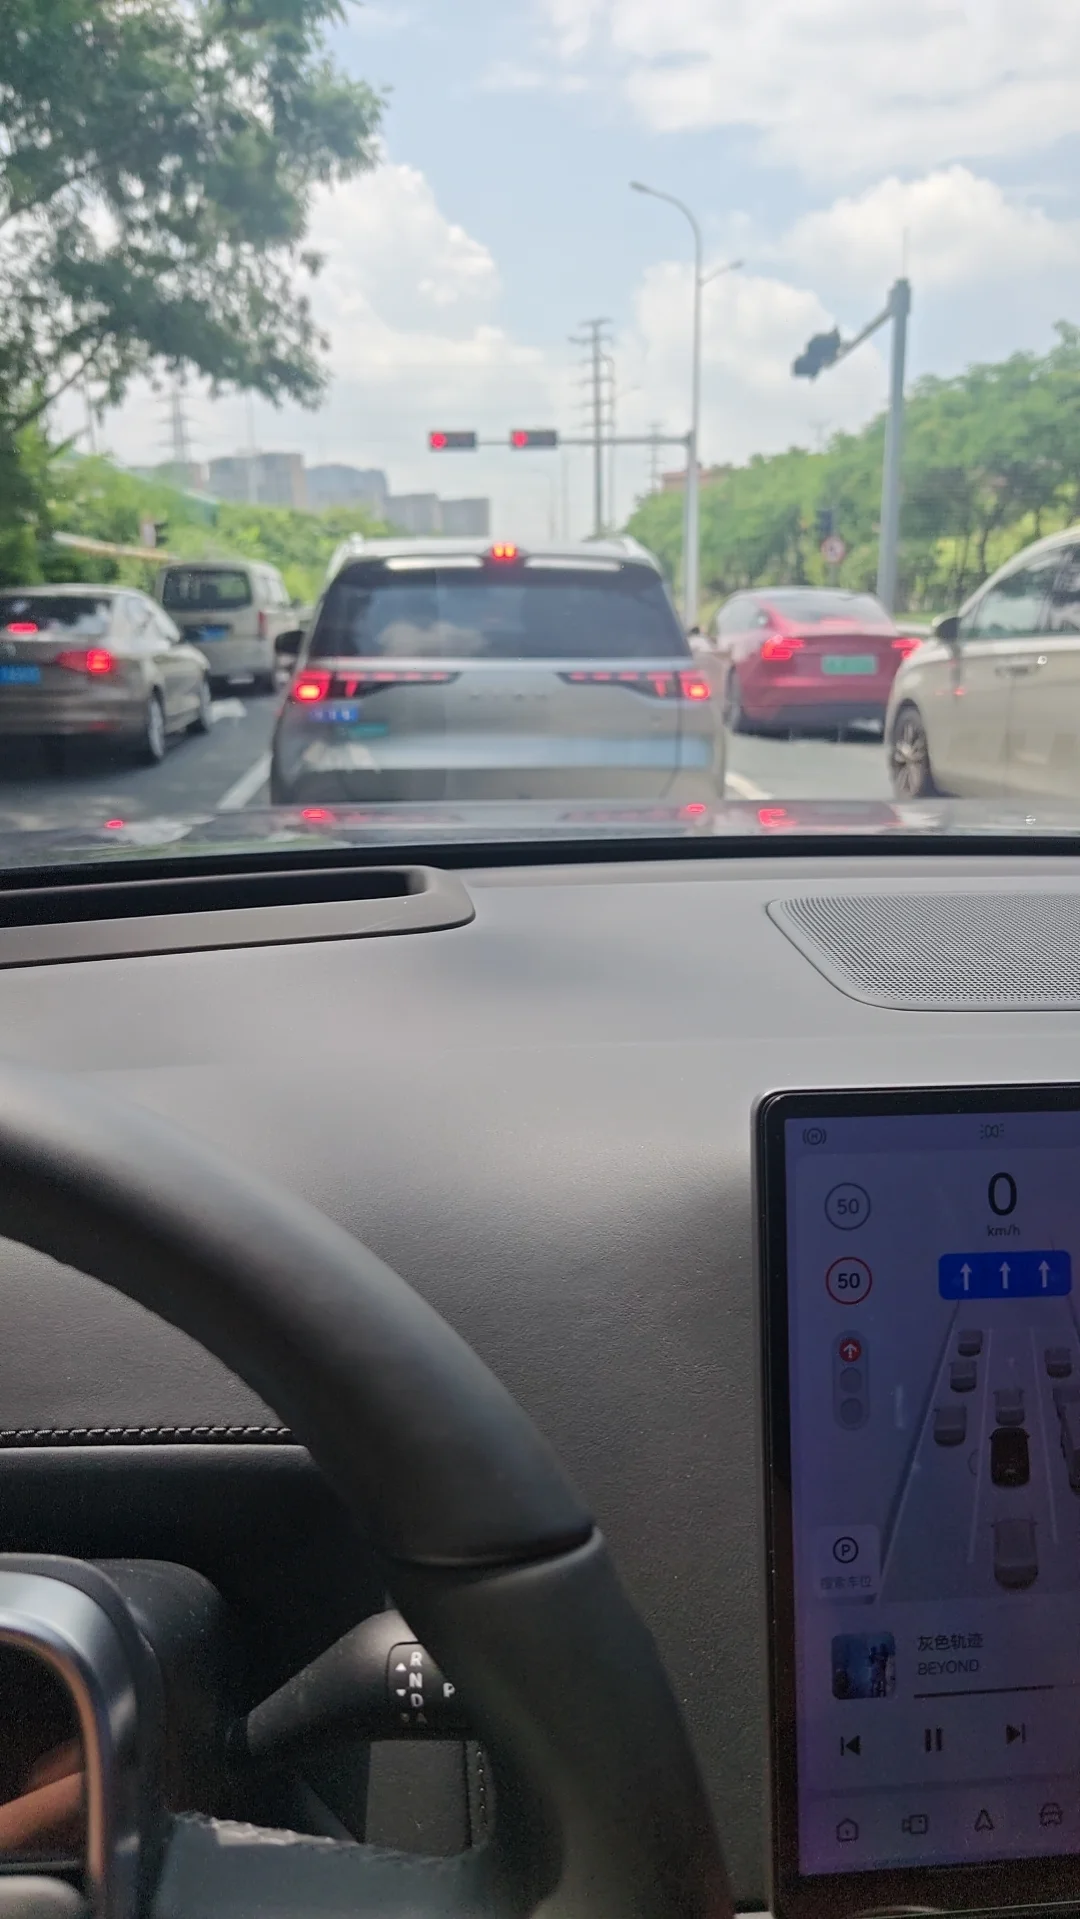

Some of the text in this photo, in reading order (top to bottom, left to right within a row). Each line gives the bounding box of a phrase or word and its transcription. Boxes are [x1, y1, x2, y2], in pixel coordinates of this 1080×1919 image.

[988, 1172, 1017, 1216] 0
[837, 1199, 860, 1215] 50
[987, 1224, 1020, 1237] km/h
[837, 1273, 861, 1289] 50
[917, 1632, 984, 1651] 灰色轨迹
[410, 1652, 422, 1666] R
[917, 1659, 980, 1675] BEYOND
[409, 1673, 422, 1688] N
[443, 1683, 455, 1697] P
[410, 1693, 423, 1706] D
